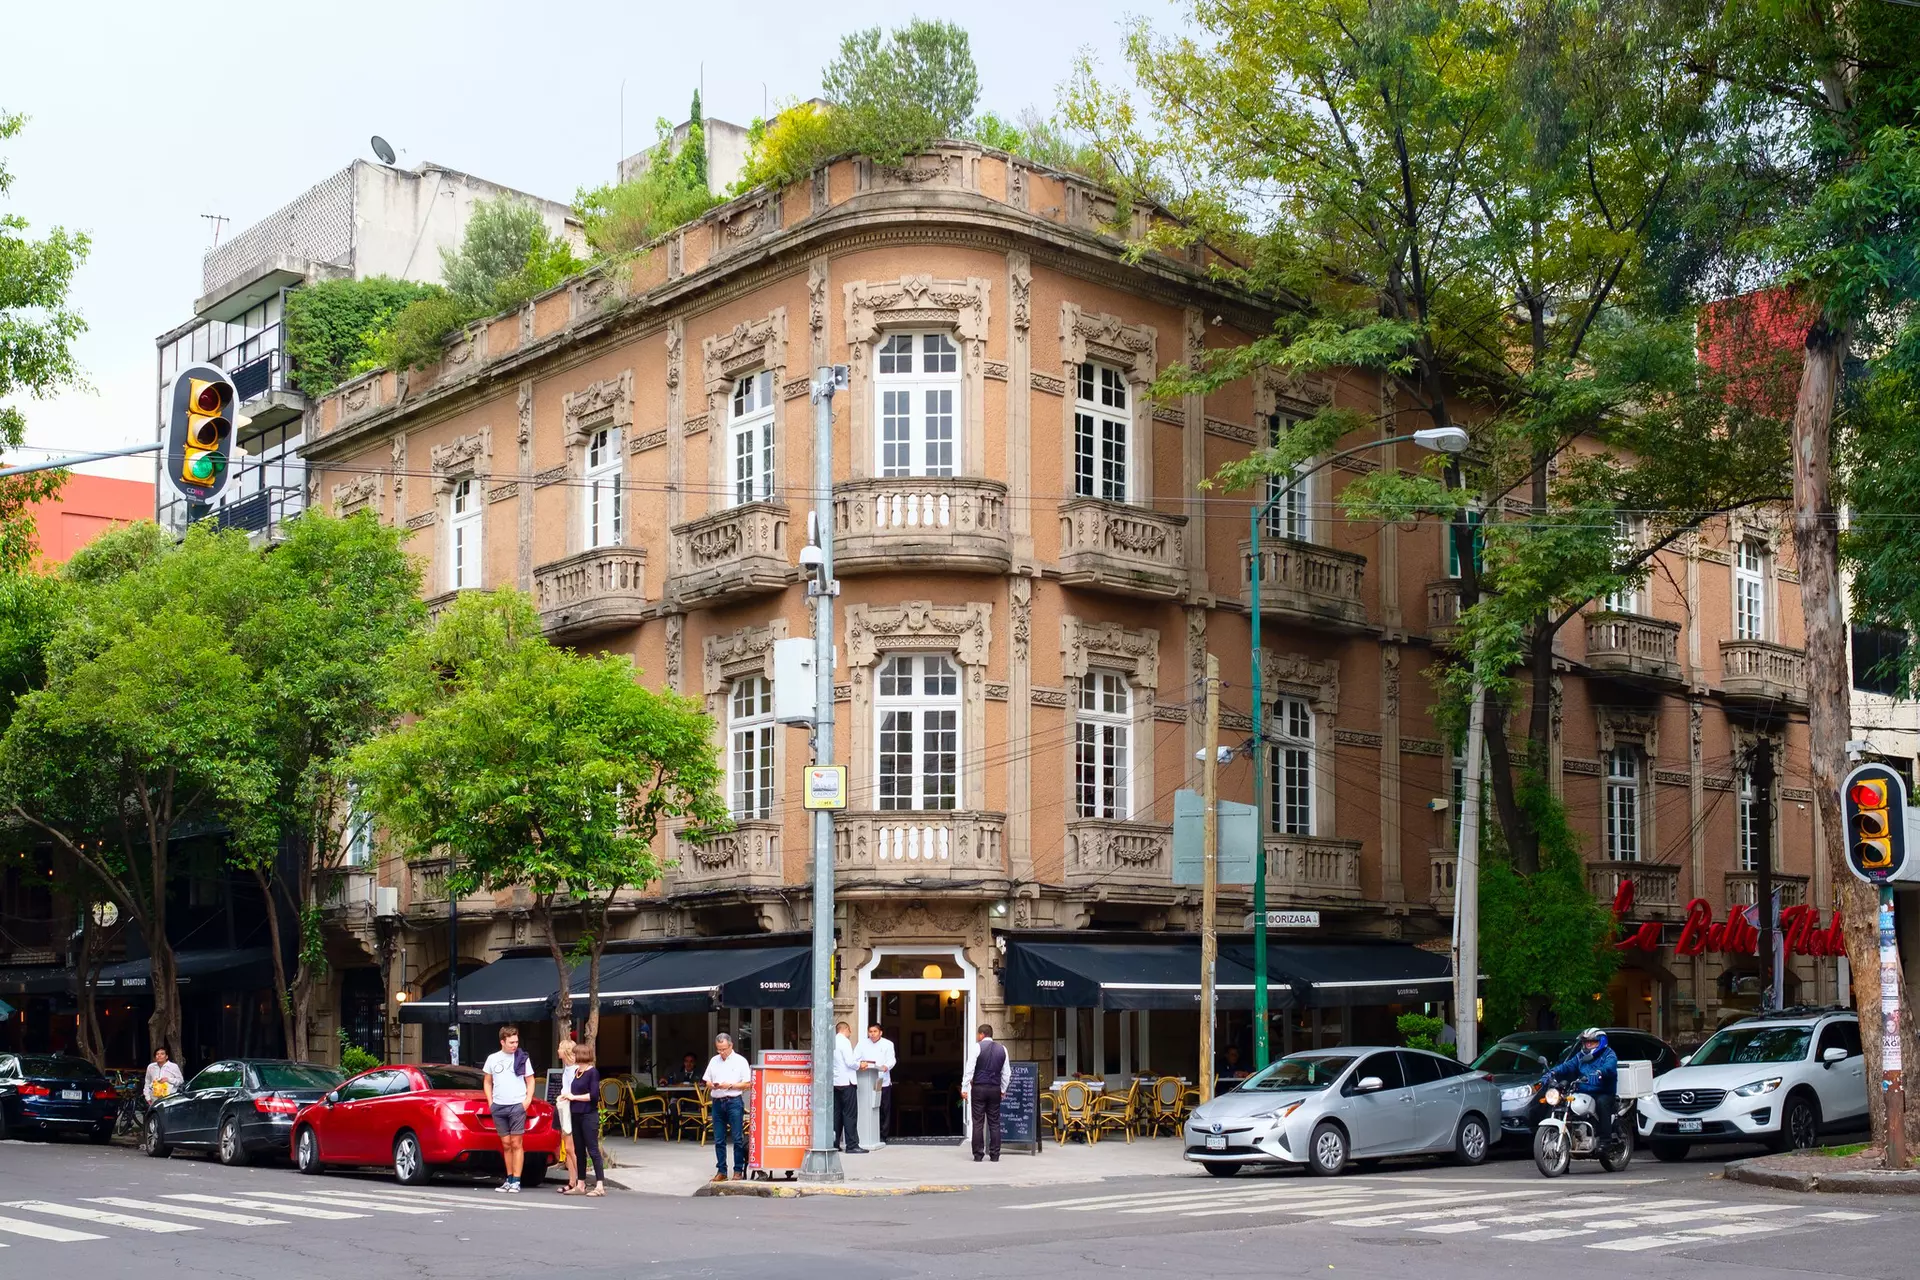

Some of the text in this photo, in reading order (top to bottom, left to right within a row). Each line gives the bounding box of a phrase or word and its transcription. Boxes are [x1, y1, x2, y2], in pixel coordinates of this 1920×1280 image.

[1274, 915, 1312, 924] ORIZABA
[760, 981, 791, 989] SOBRINOS
[766, 1084, 784, 1094] NOS
[765, 1095, 811, 1109] CONDE
[768, 1115, 811, 1125] POLANC
[768, 1125, 806, 1135] SANTA
[768, 1135, 811, 1145] SAN ANG
